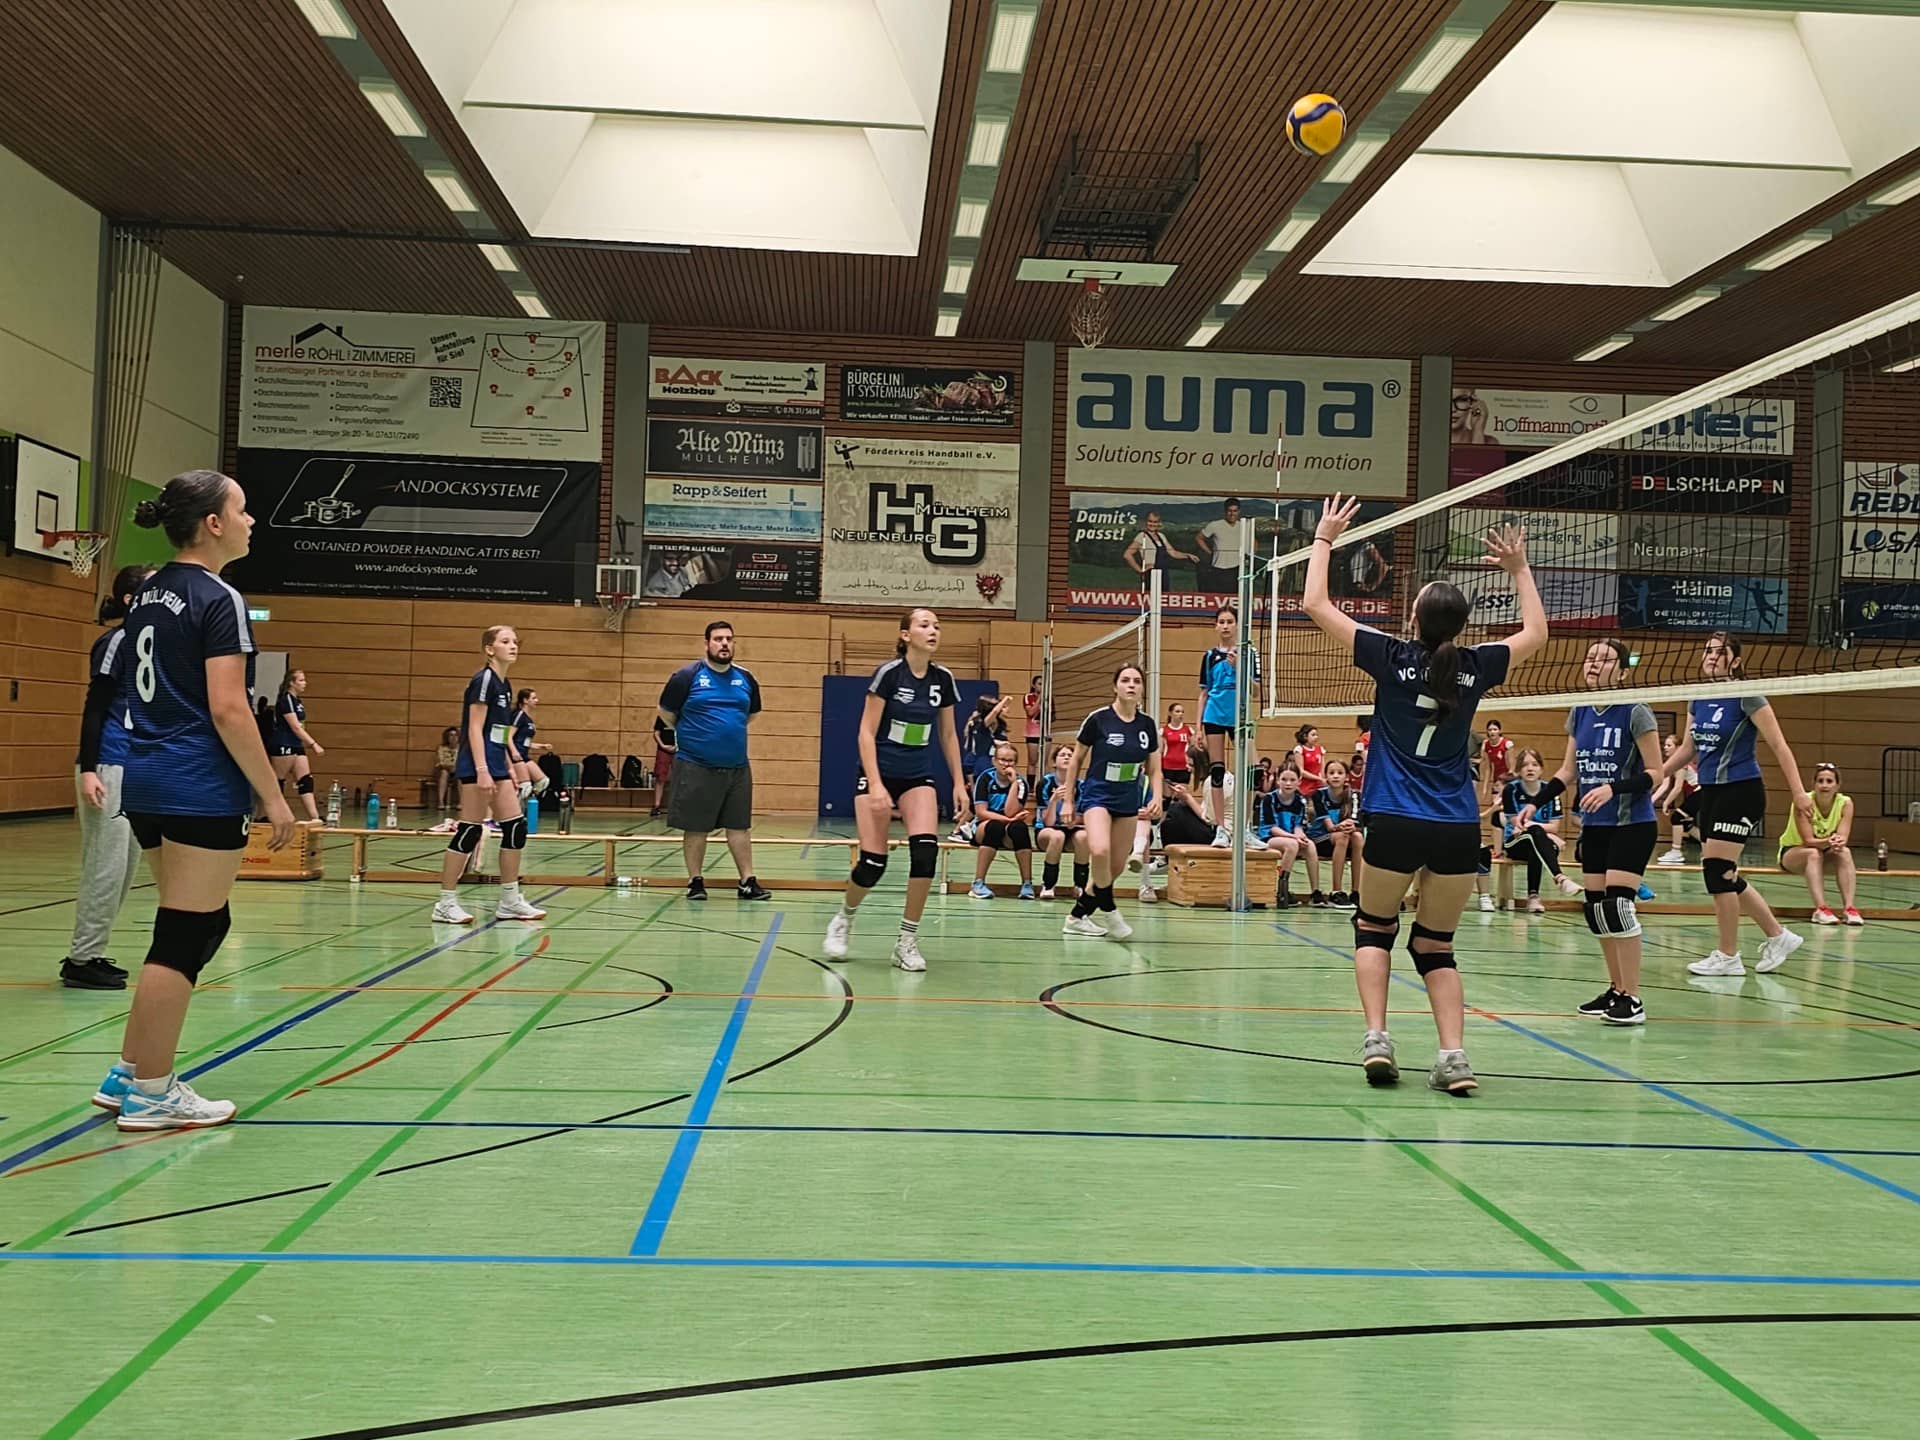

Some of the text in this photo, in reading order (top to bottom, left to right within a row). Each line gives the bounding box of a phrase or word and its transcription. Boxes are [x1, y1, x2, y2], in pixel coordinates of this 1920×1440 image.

[255, 335, 305, 359] merle
[351, 350, 416, 365] ZIMMEREI
[847, 369, 901, 387] BÜRGELIN
[663, 385, 716, 397] Holzbau
[847, 387, 921, 400] IT SYSTEMHAUS
[1077, 372, 1374, 438] auma
[865, 446, 997, 460] Förderkreis Handball e.V.
[1075, 445, 1373, 472] Solutions for a world in motion
[395, 479, 542, 499] ANDOCKSYSTEME
[673, 483, 768, 499] Rapp & Seifert
[916, 501, 1010, 519] MÜLLHEIM
[1076, 509, 1139, 526] Damit's
[831, 527, 937, 545] NEUENBURG
[1075, 528, 1126, 544] passt!
[293, 540, 362, 555] CONTAINED
[363, 544, 414, 557] POWDER
[414, 546, 476, 559] HANDLING
[354, 561, 479, 577] www.andocksysteme.de
[135, 624, 156, 703] 8
[1398, 666, 1417, 682] VC
[929, 684, 942, 708] 5
[1711, 706, 1725, 723] 6
[1415, 693, 1441, 757] 7
[1138, 730, 1150, 750] 9
[1179, 732, 1191, 743] 11
[1602, 727, 1622, 748] 11
[280, 746, 292, 755] 14
[856, 776, 867, 790] 5
[1712, 820, 1749, 836] PUMA
